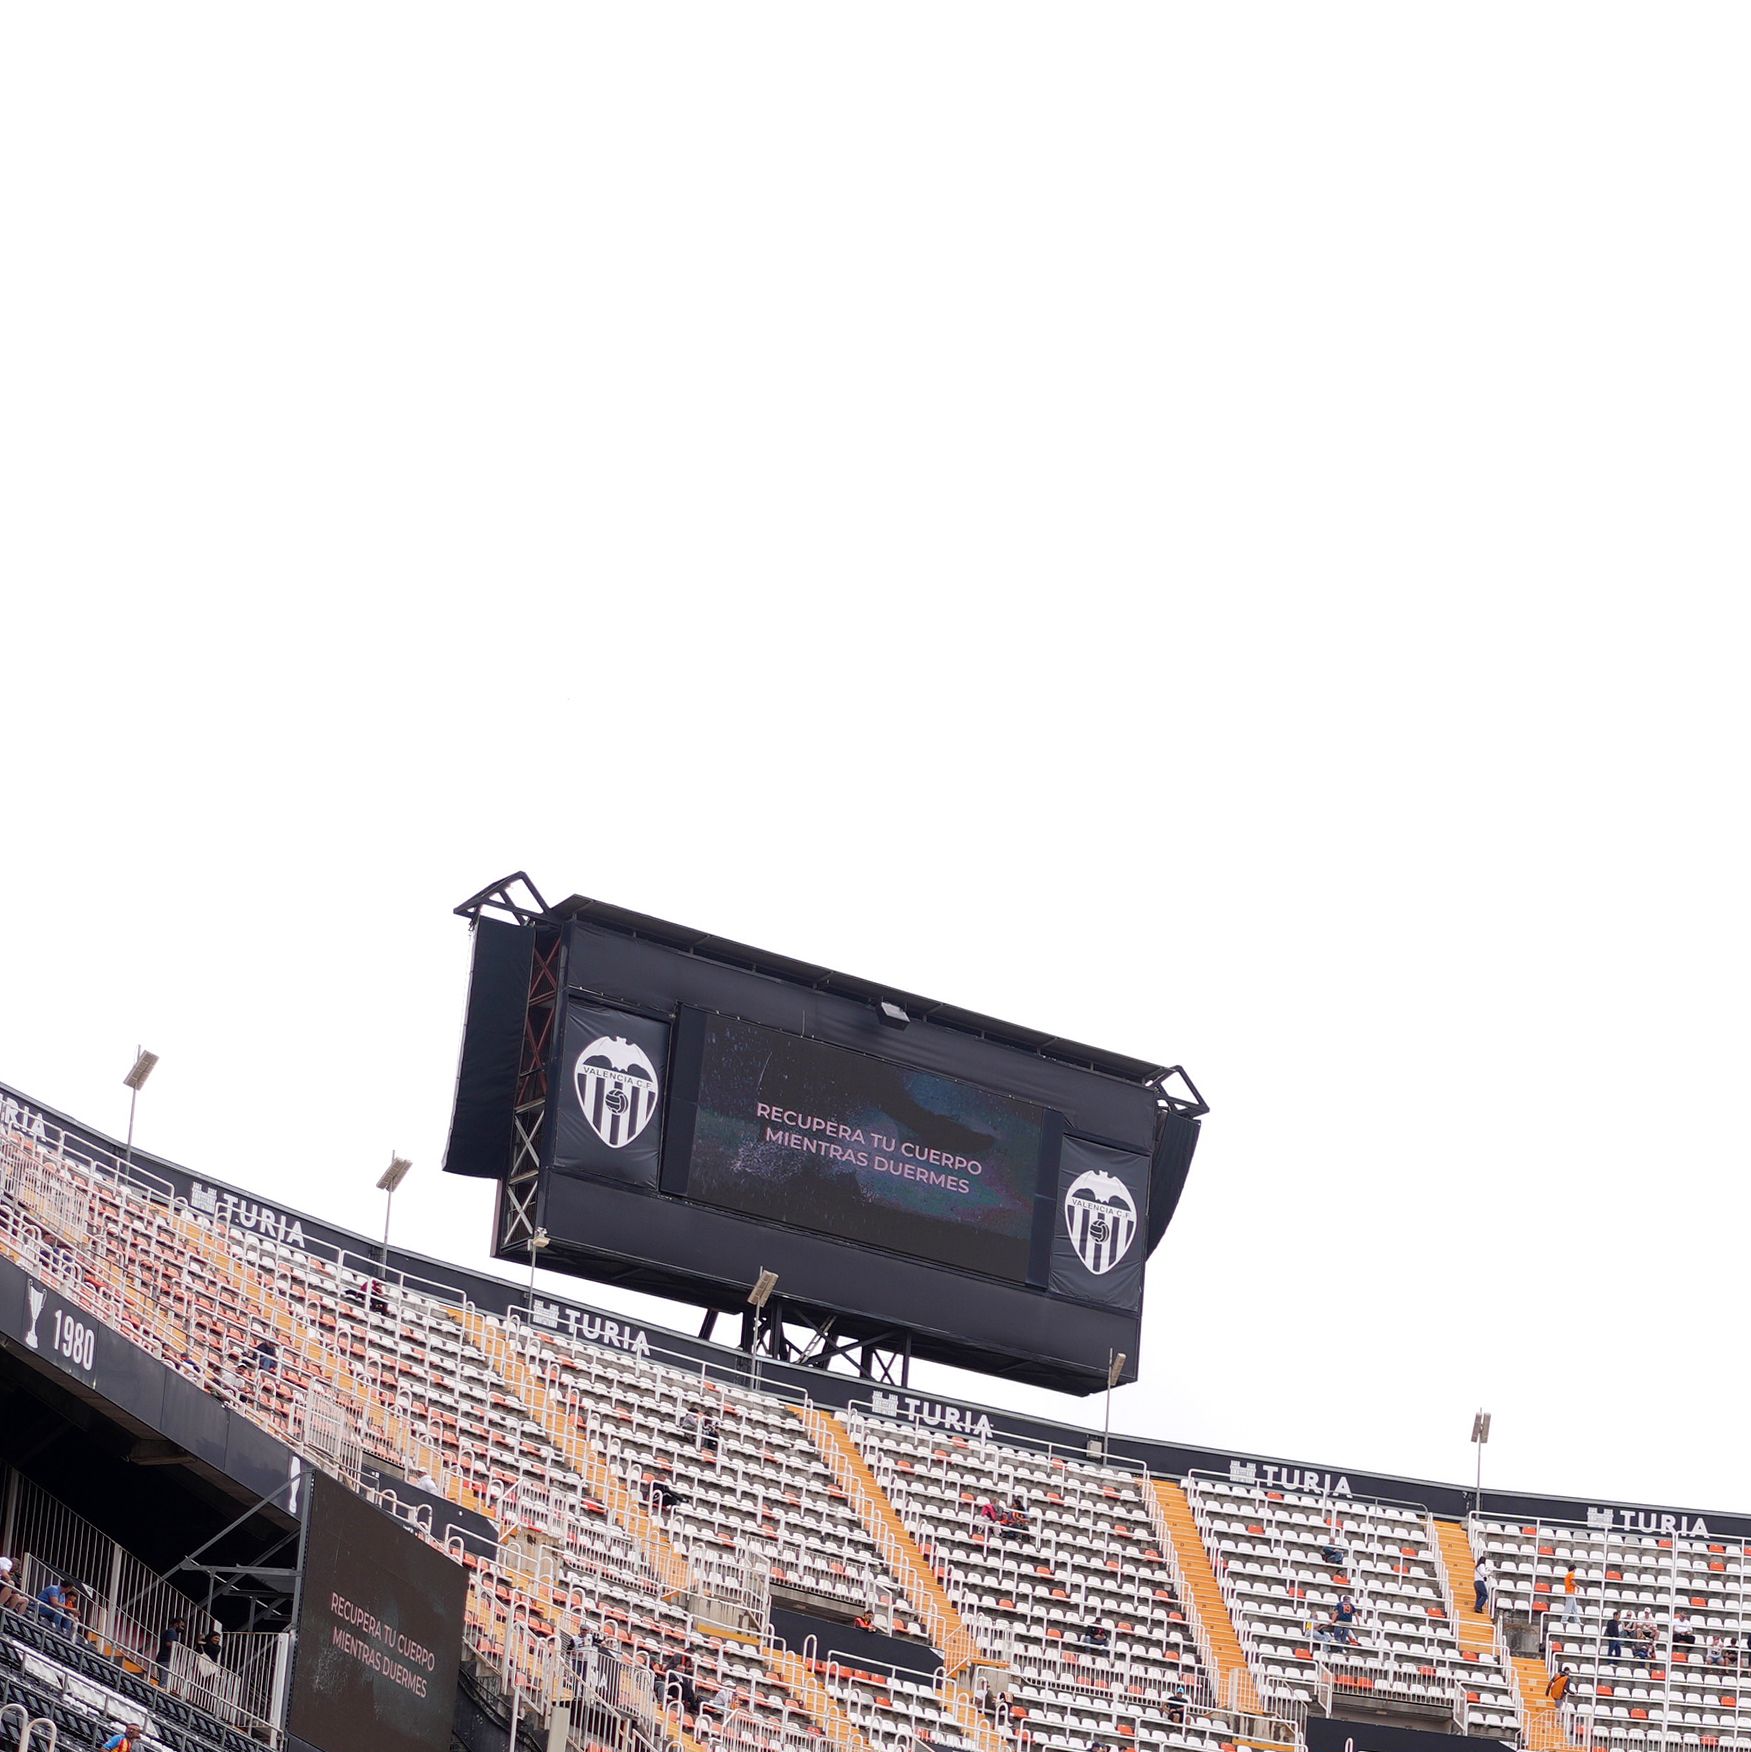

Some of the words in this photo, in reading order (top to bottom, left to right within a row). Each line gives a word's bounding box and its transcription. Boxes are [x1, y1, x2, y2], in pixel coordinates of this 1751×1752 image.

[583, 1065, 634, 1084] VALENCIA
[756, 1102, 864, 1145] RECUPERA
[869, 1130, 896, 1153] TU
[901, 1142, 983, 1176] CUERPO
[766, 1127, 869, 1168] MIENTRAS
[874, 1155, 970, 1194] DUERMES
[223, 1192, 305, 1249] TURIA
[1071, 1199, 1116, 1216] VALENCIA
[54, 1309, 95, 1371] 1980
[564, 1308, 651, 1357] TURIA
[904, 1398, 993, 1438] TURIA
[1262, 1465, 1353, 1499] TURIA
[1619, 1509, 1710, 1540] TURIA
[331, 1591, 381, 1641] RECUPERA
[383, 1624, 398, 1648] TU
[399, 1631, 435, 1672] CUERPO
[332, 1626, 381, 1673] MIENTRAS
[382, 1661, 428, 1699] DUERMES
